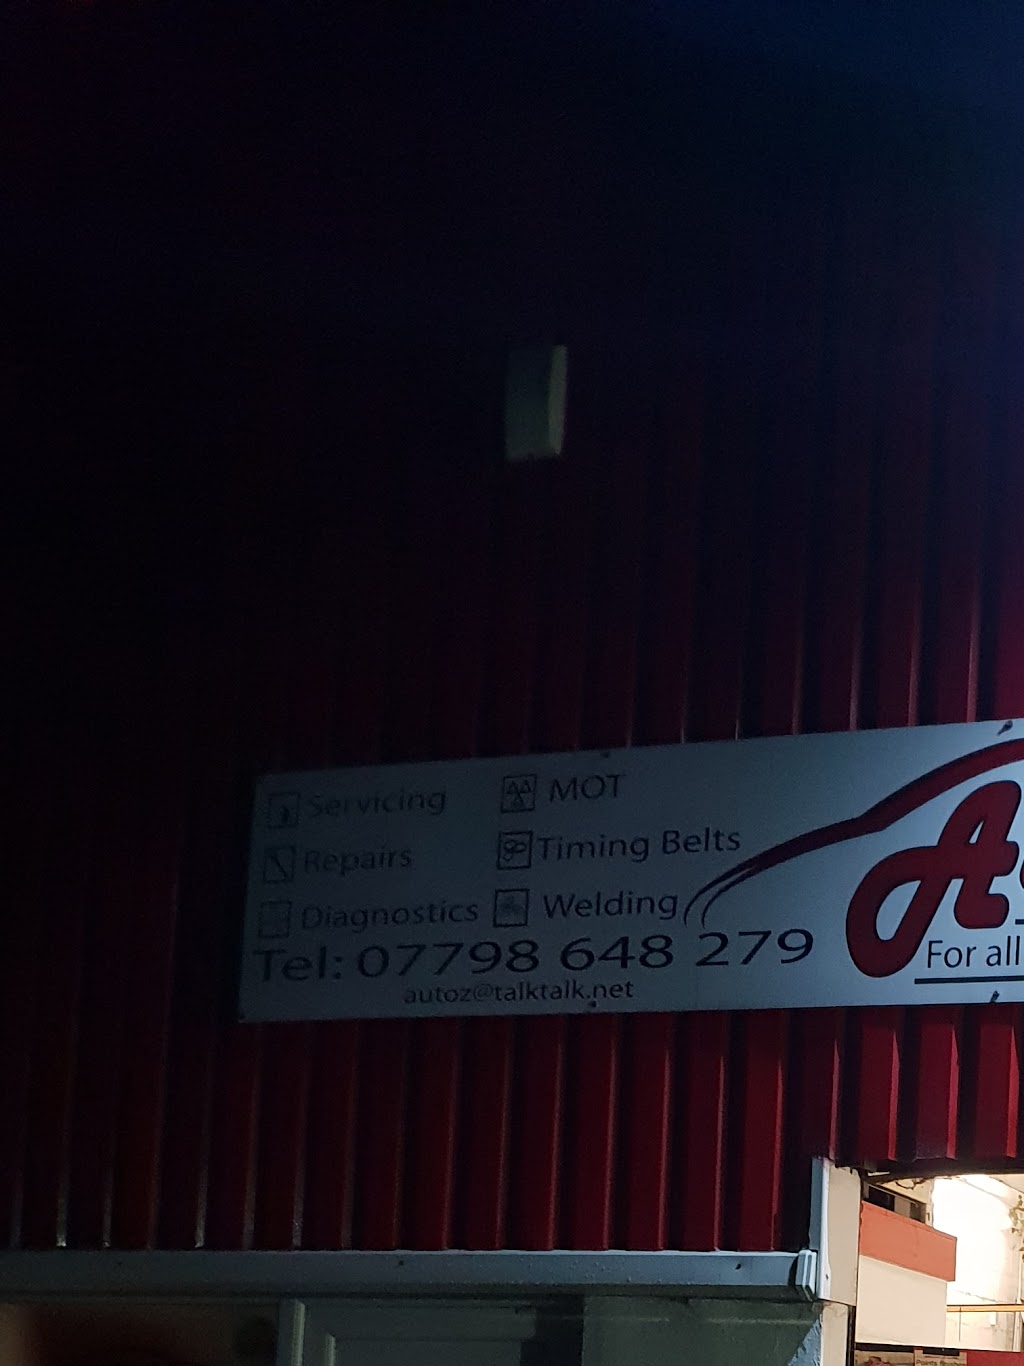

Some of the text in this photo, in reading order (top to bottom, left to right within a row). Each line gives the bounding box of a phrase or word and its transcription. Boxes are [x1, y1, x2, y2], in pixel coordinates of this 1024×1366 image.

[308, 789, 447, 816] Servicing
[550, 775, 626, 802] MOT
[304, 845, 413, 876] Repairs
[537, 827, 741, 863] Timing Belts
[302, 901, 478, 934] Diagnostics
[544, 890, 678, 920] Welding
[252, 928, 814, 983] Tel: 07798 648 279
[927, 940, 977, 969] For
[985, 935, 1021, 966] all
[403, 979, 635, 1005] autoz@talktalk.net
